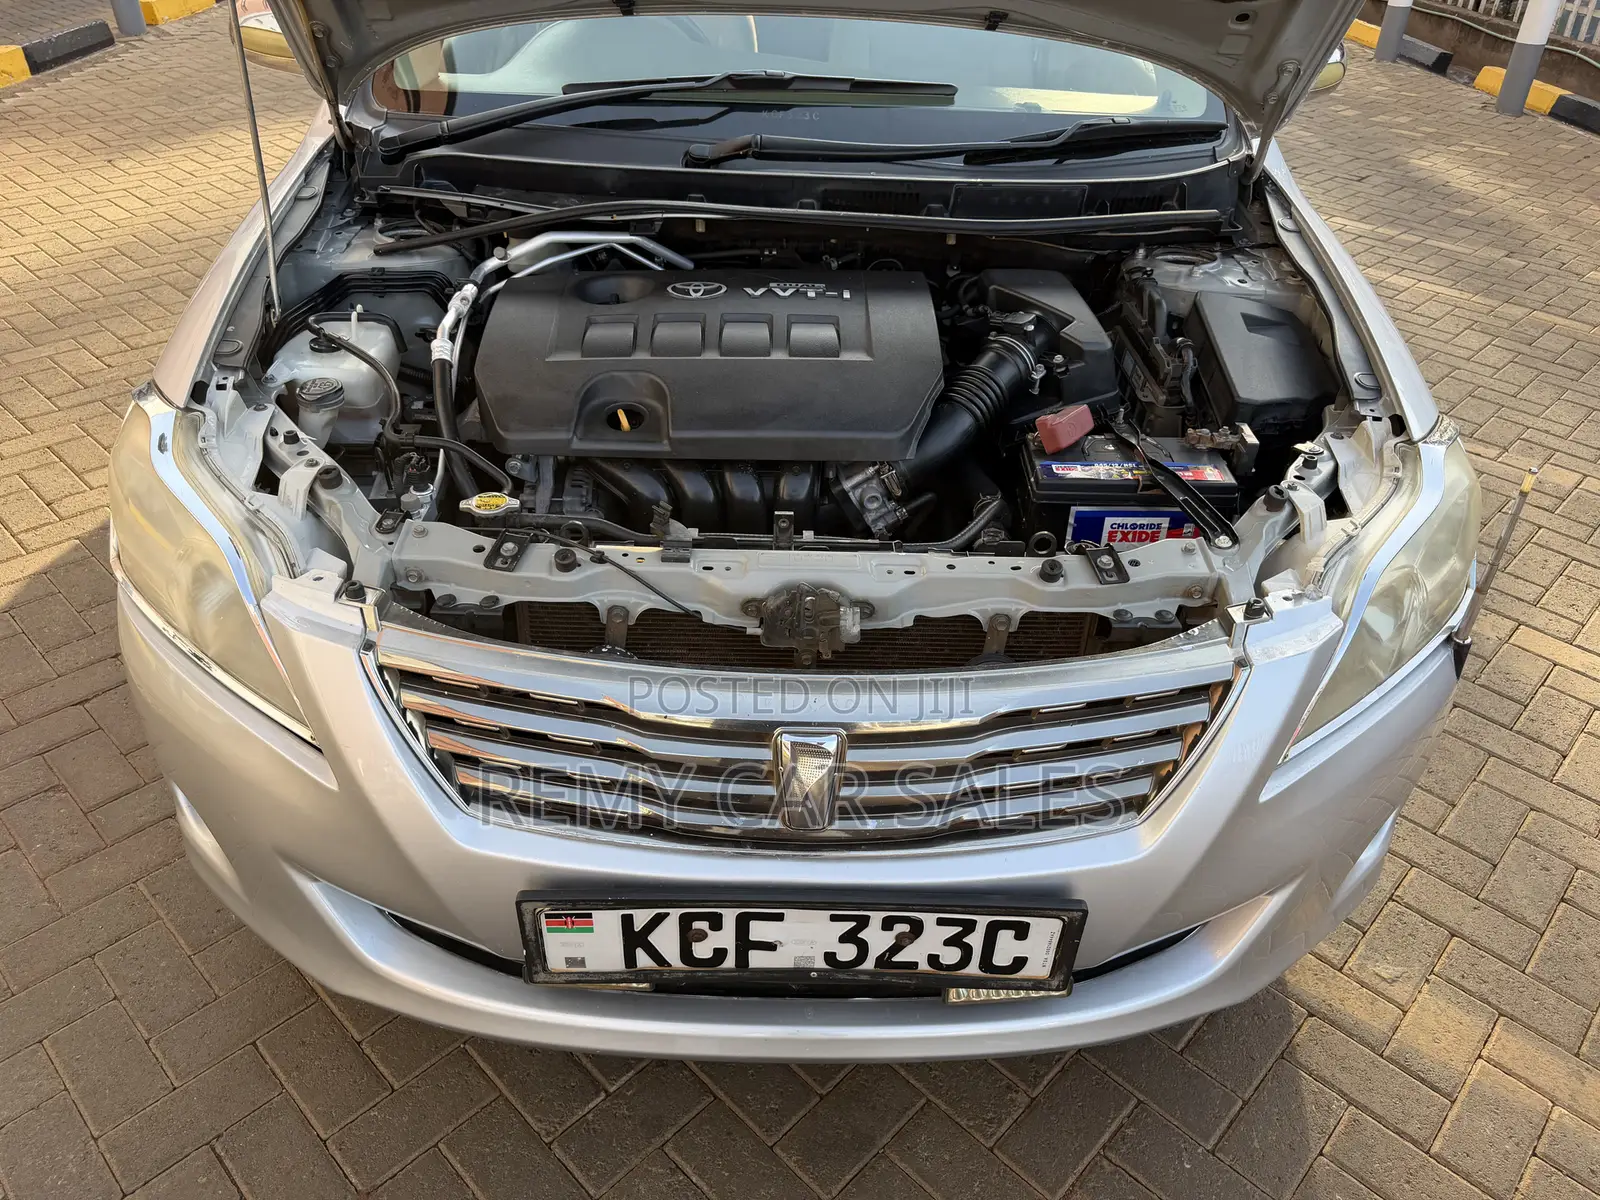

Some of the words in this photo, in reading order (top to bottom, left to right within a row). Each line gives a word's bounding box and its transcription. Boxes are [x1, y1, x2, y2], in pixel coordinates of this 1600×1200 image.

[1110, 522, 1163, 531] CHLORIDE
[1107, 530, 1161, 543] EXIDE
[621, 911, 786, 970] KCF
[823, 913, 1031, 976] 323C
